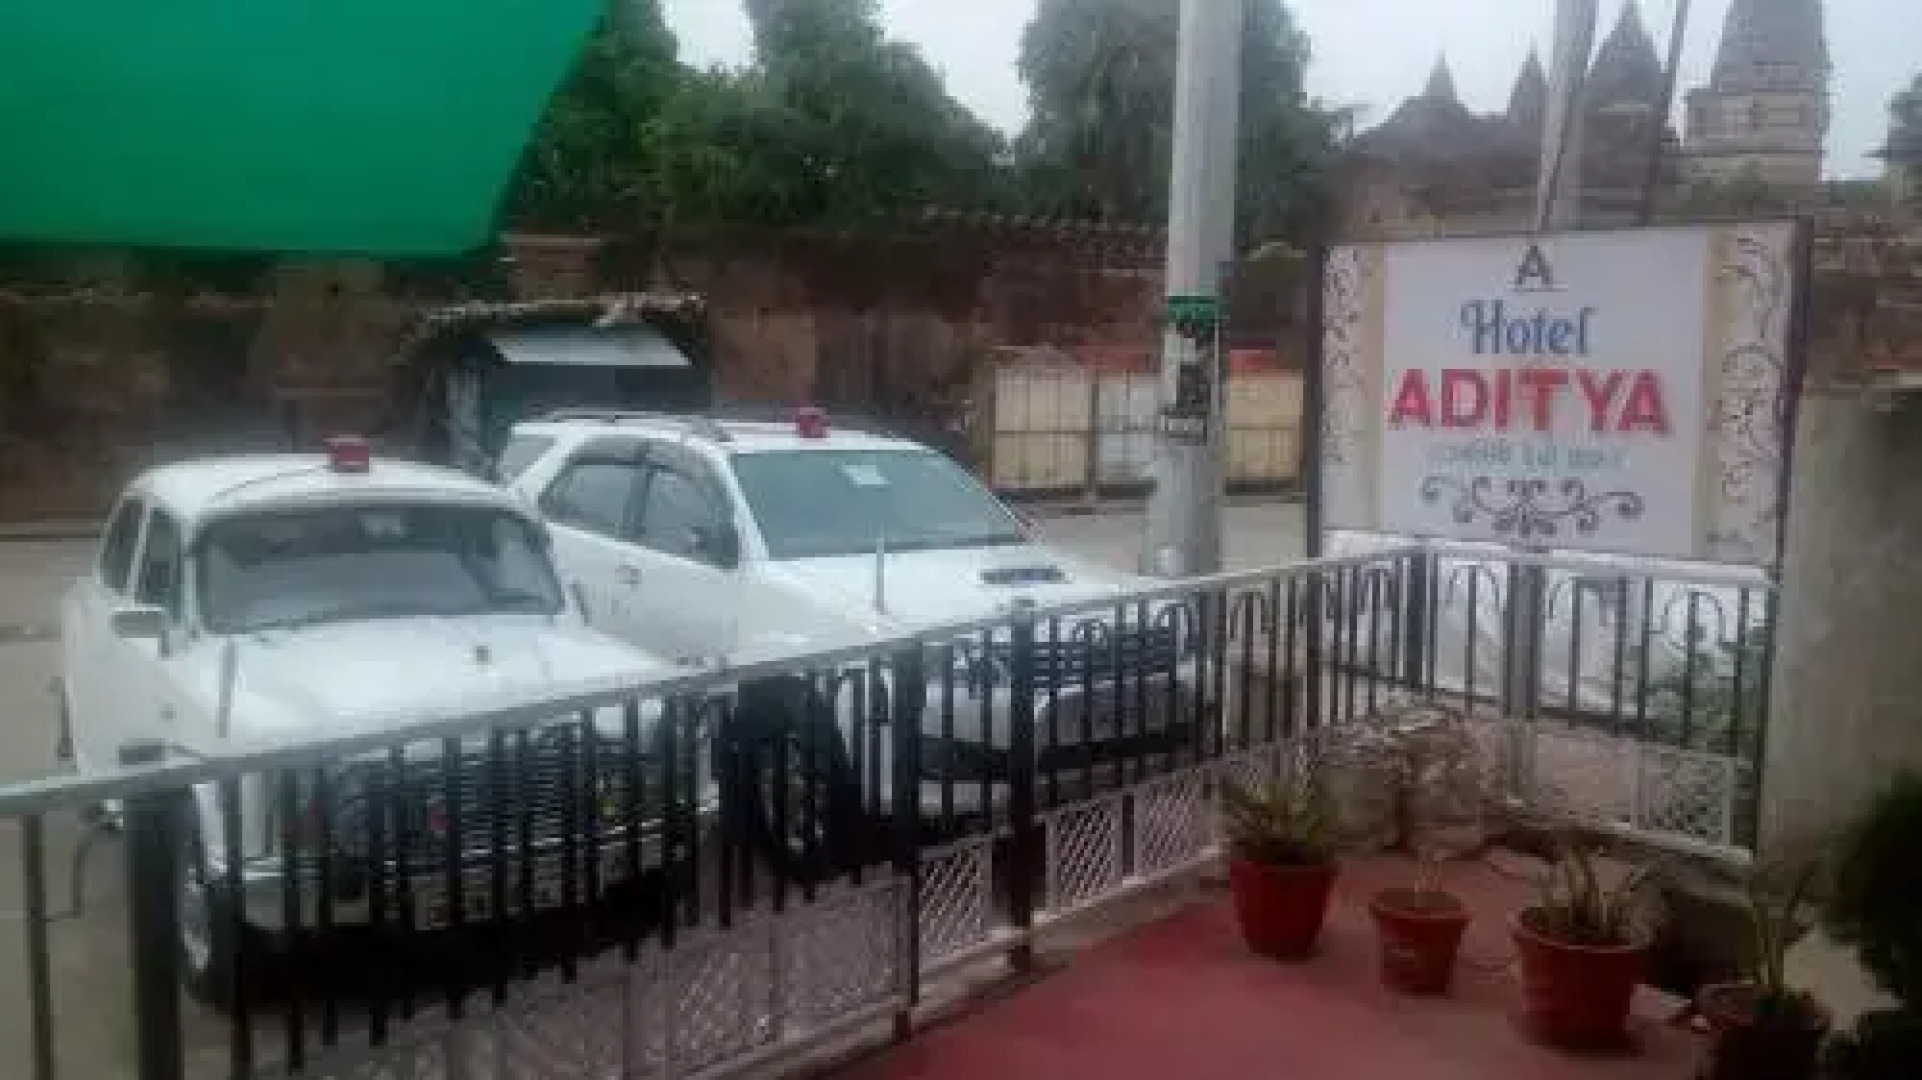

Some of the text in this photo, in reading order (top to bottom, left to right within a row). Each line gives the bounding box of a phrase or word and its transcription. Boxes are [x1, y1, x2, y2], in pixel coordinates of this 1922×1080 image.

[1515, 244, 1555, 288] A
[1460, 299, 1597, 356] Hotel
[1387, 367, 1671, 435] ADITYA
